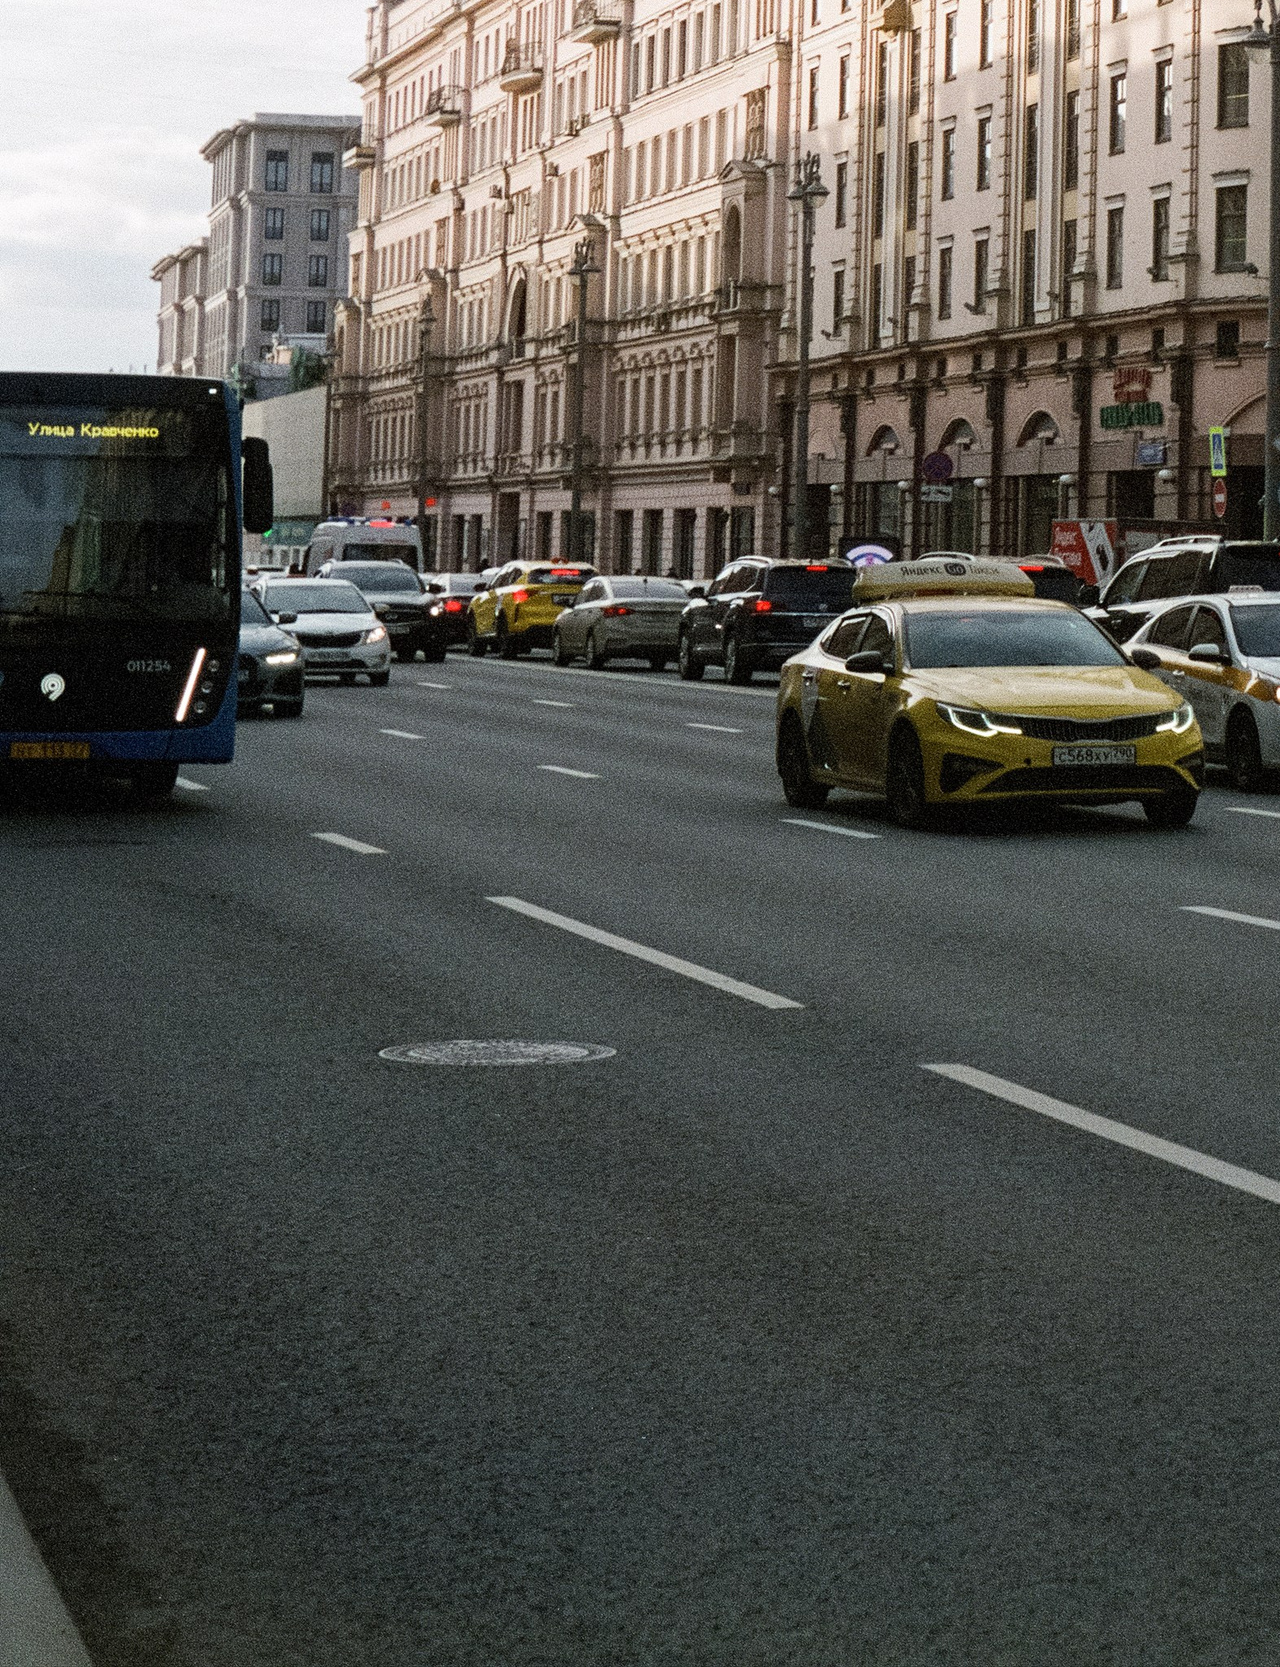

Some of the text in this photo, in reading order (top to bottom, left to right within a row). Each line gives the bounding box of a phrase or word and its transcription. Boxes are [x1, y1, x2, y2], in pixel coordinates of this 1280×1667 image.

[28, 422, 160, 438] Улица Кравченко
[900, 566, 941, 576] Яндекс
[126, 660, 171, 673] 011254
